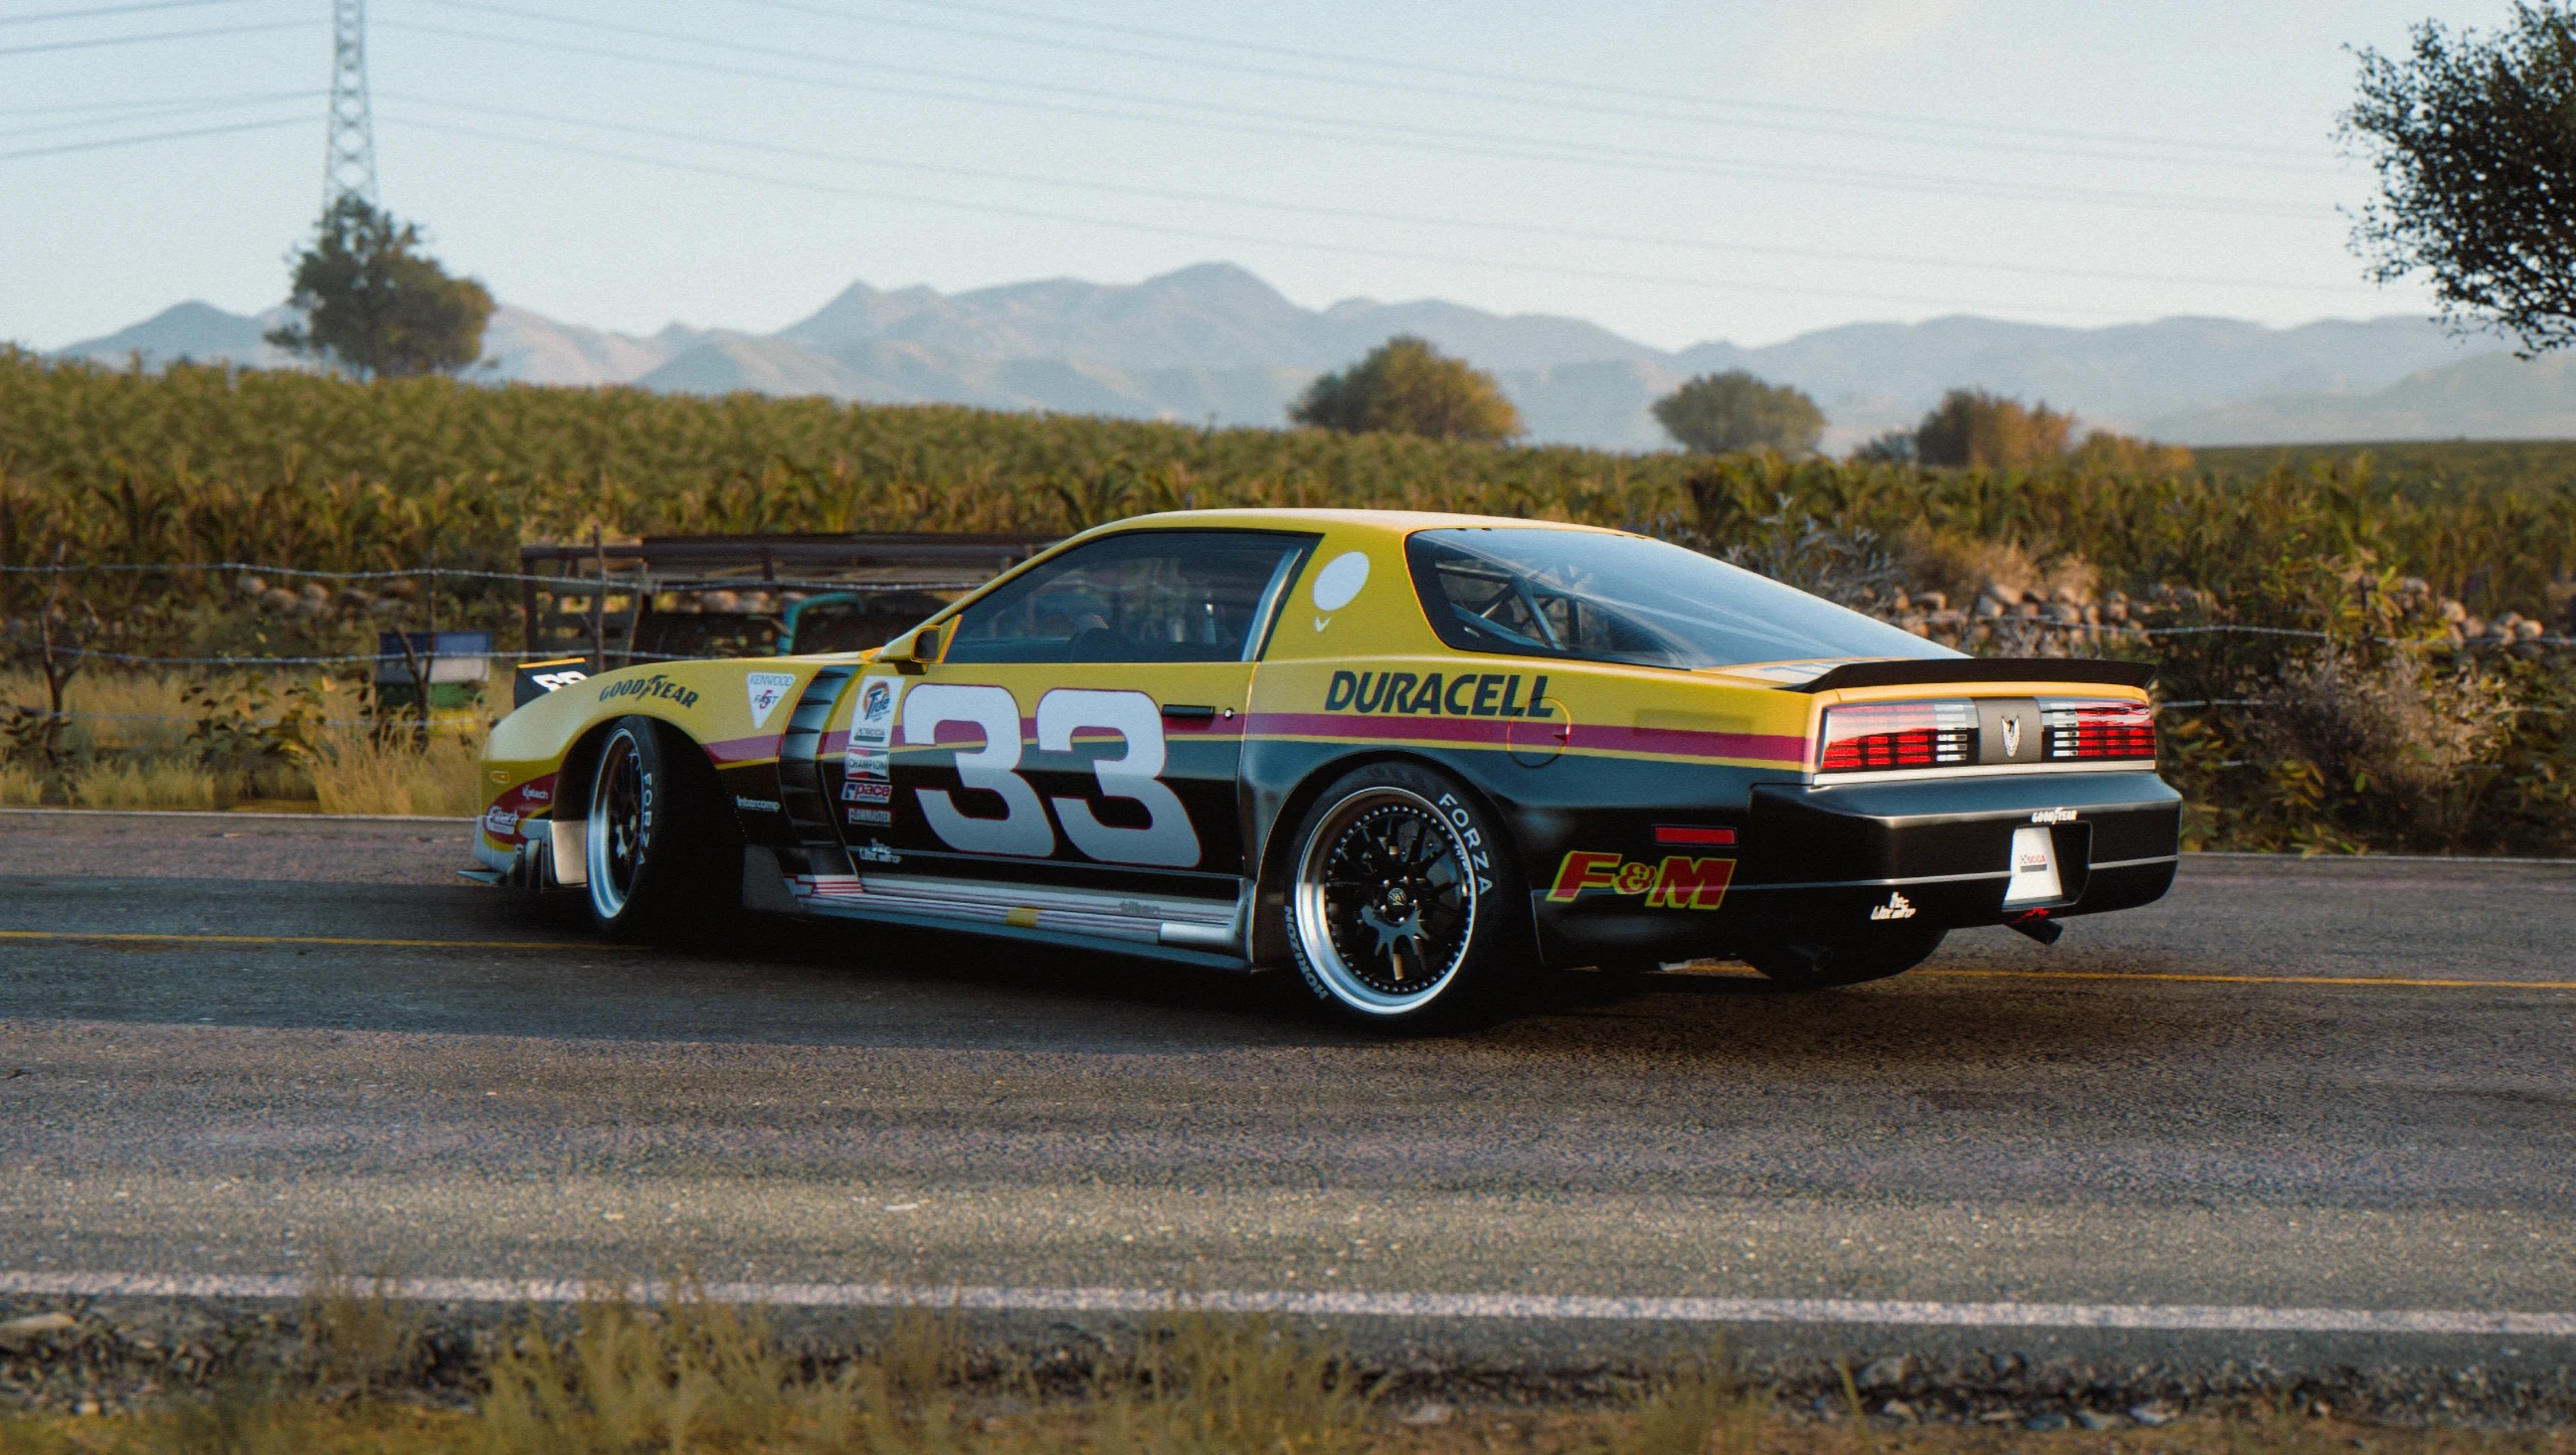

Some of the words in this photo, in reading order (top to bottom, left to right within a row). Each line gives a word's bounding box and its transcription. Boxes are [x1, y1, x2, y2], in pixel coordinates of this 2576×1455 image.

[599, 674, 699, 708] GOODYEAR
[864, 689, 890, 720] Tide
[1325, 670, 1555, 717] DURACELL
[849, 758, 887, 772] CHAMPION
[902, 682, 1202, 867] 33
[854, 783, 890, 799] pace
[1438, 793, 1493, 895] FORZA
[1546, 850, 1737, 910] F&M
[1283, 904, 1329, 1000] HORIZON
